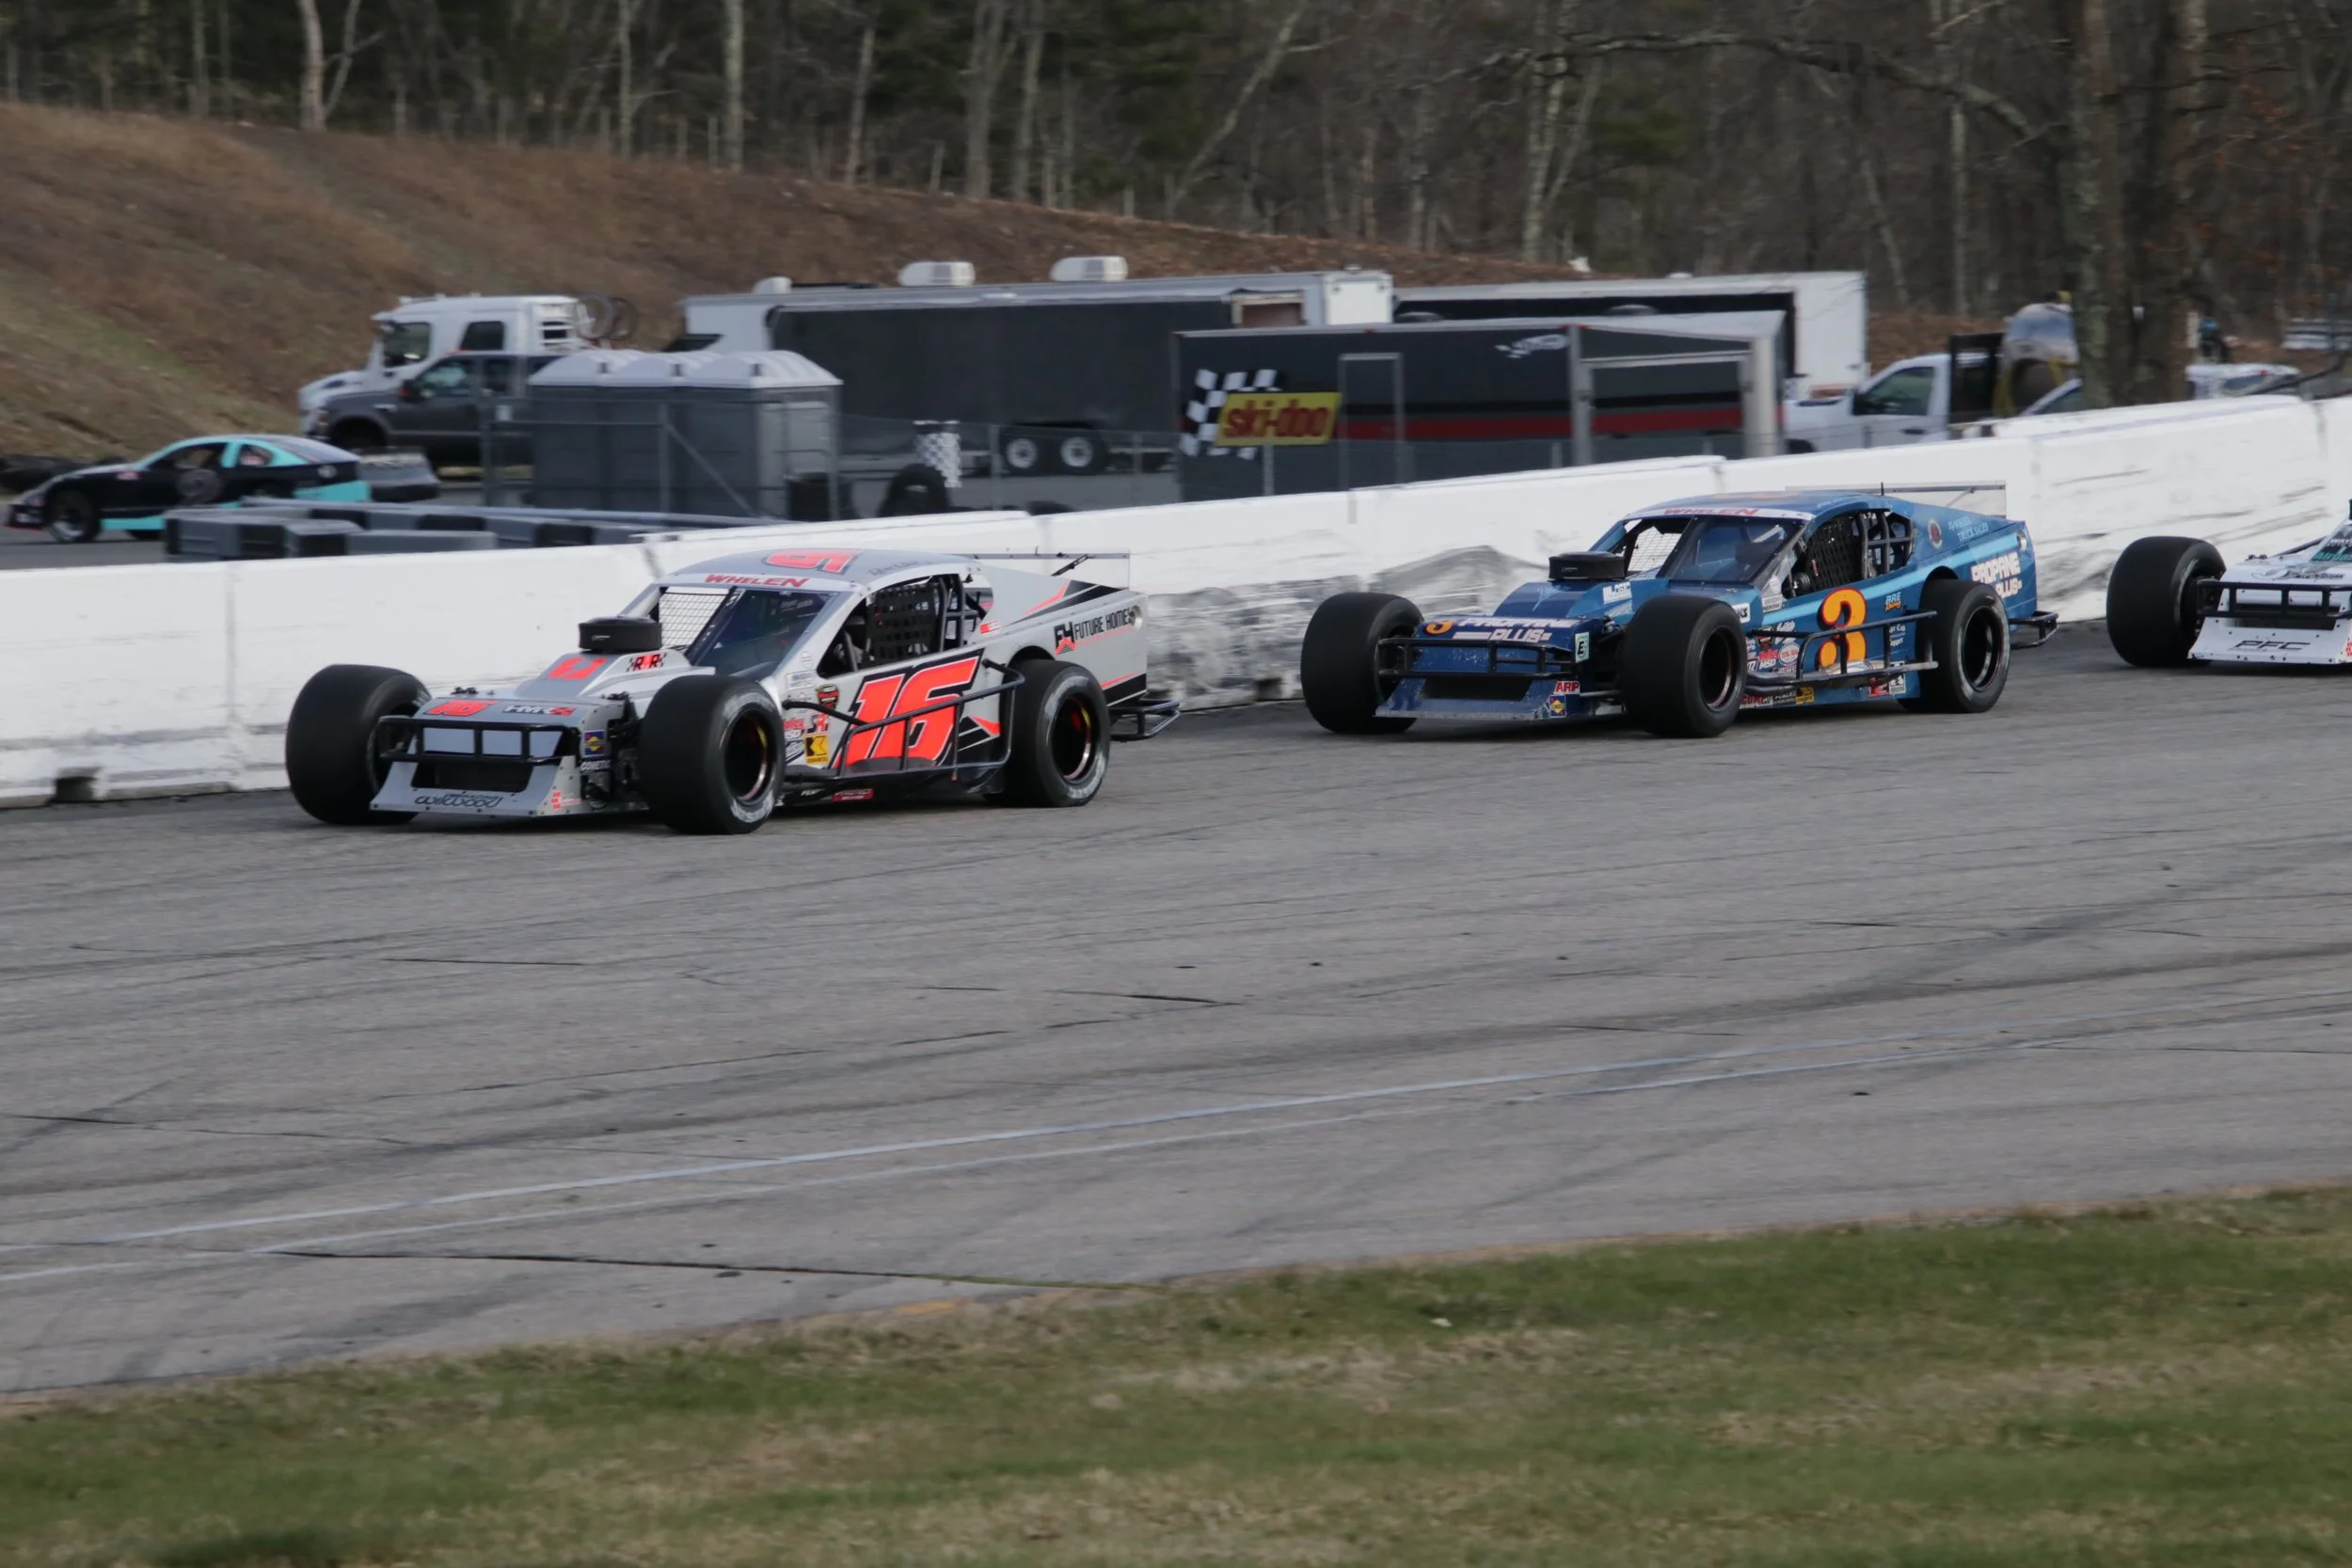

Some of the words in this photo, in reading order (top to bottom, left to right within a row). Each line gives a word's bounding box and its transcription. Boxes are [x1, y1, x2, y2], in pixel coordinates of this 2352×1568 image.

[705, 573, 811, 588] WHELEN
[1074, 616, 1104, 641] FUTURE
[1817, 587, 1867, 669] 3
[2234, 641, 2311, 651] PFC
[1555, 682, 1580, 692] ARP
[834, 651, 983, 768] 16
